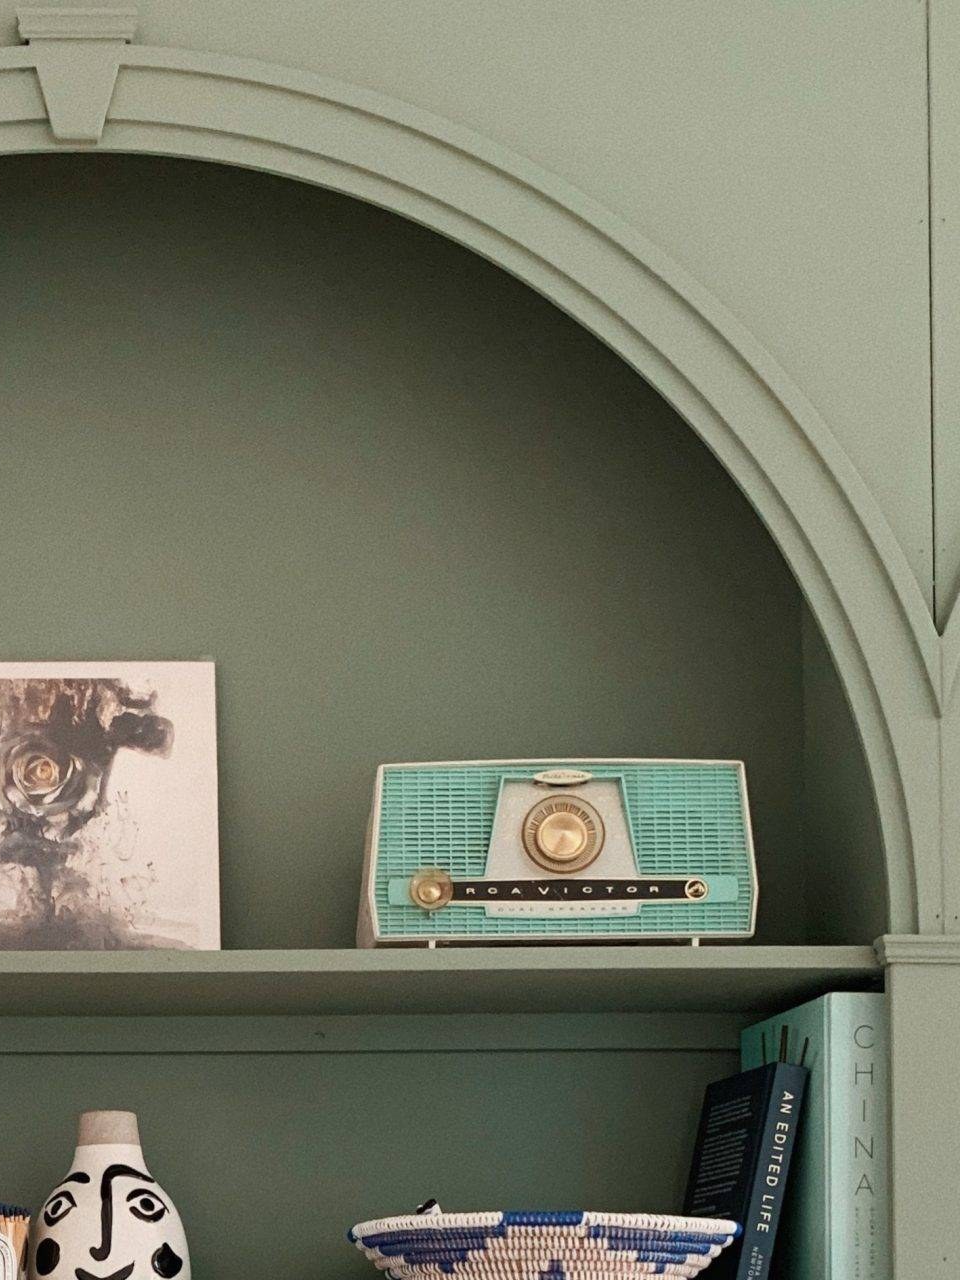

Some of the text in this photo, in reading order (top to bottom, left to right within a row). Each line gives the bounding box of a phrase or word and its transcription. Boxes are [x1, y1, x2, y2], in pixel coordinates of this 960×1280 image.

[465, 886, 660, 895] RCA VICTOR
[854, 1024, 875, 1196] CHINA
[756, 1091, 794, 1233] AN EDITED LIFE
[754, 1253, 765, 1278] ANNA
